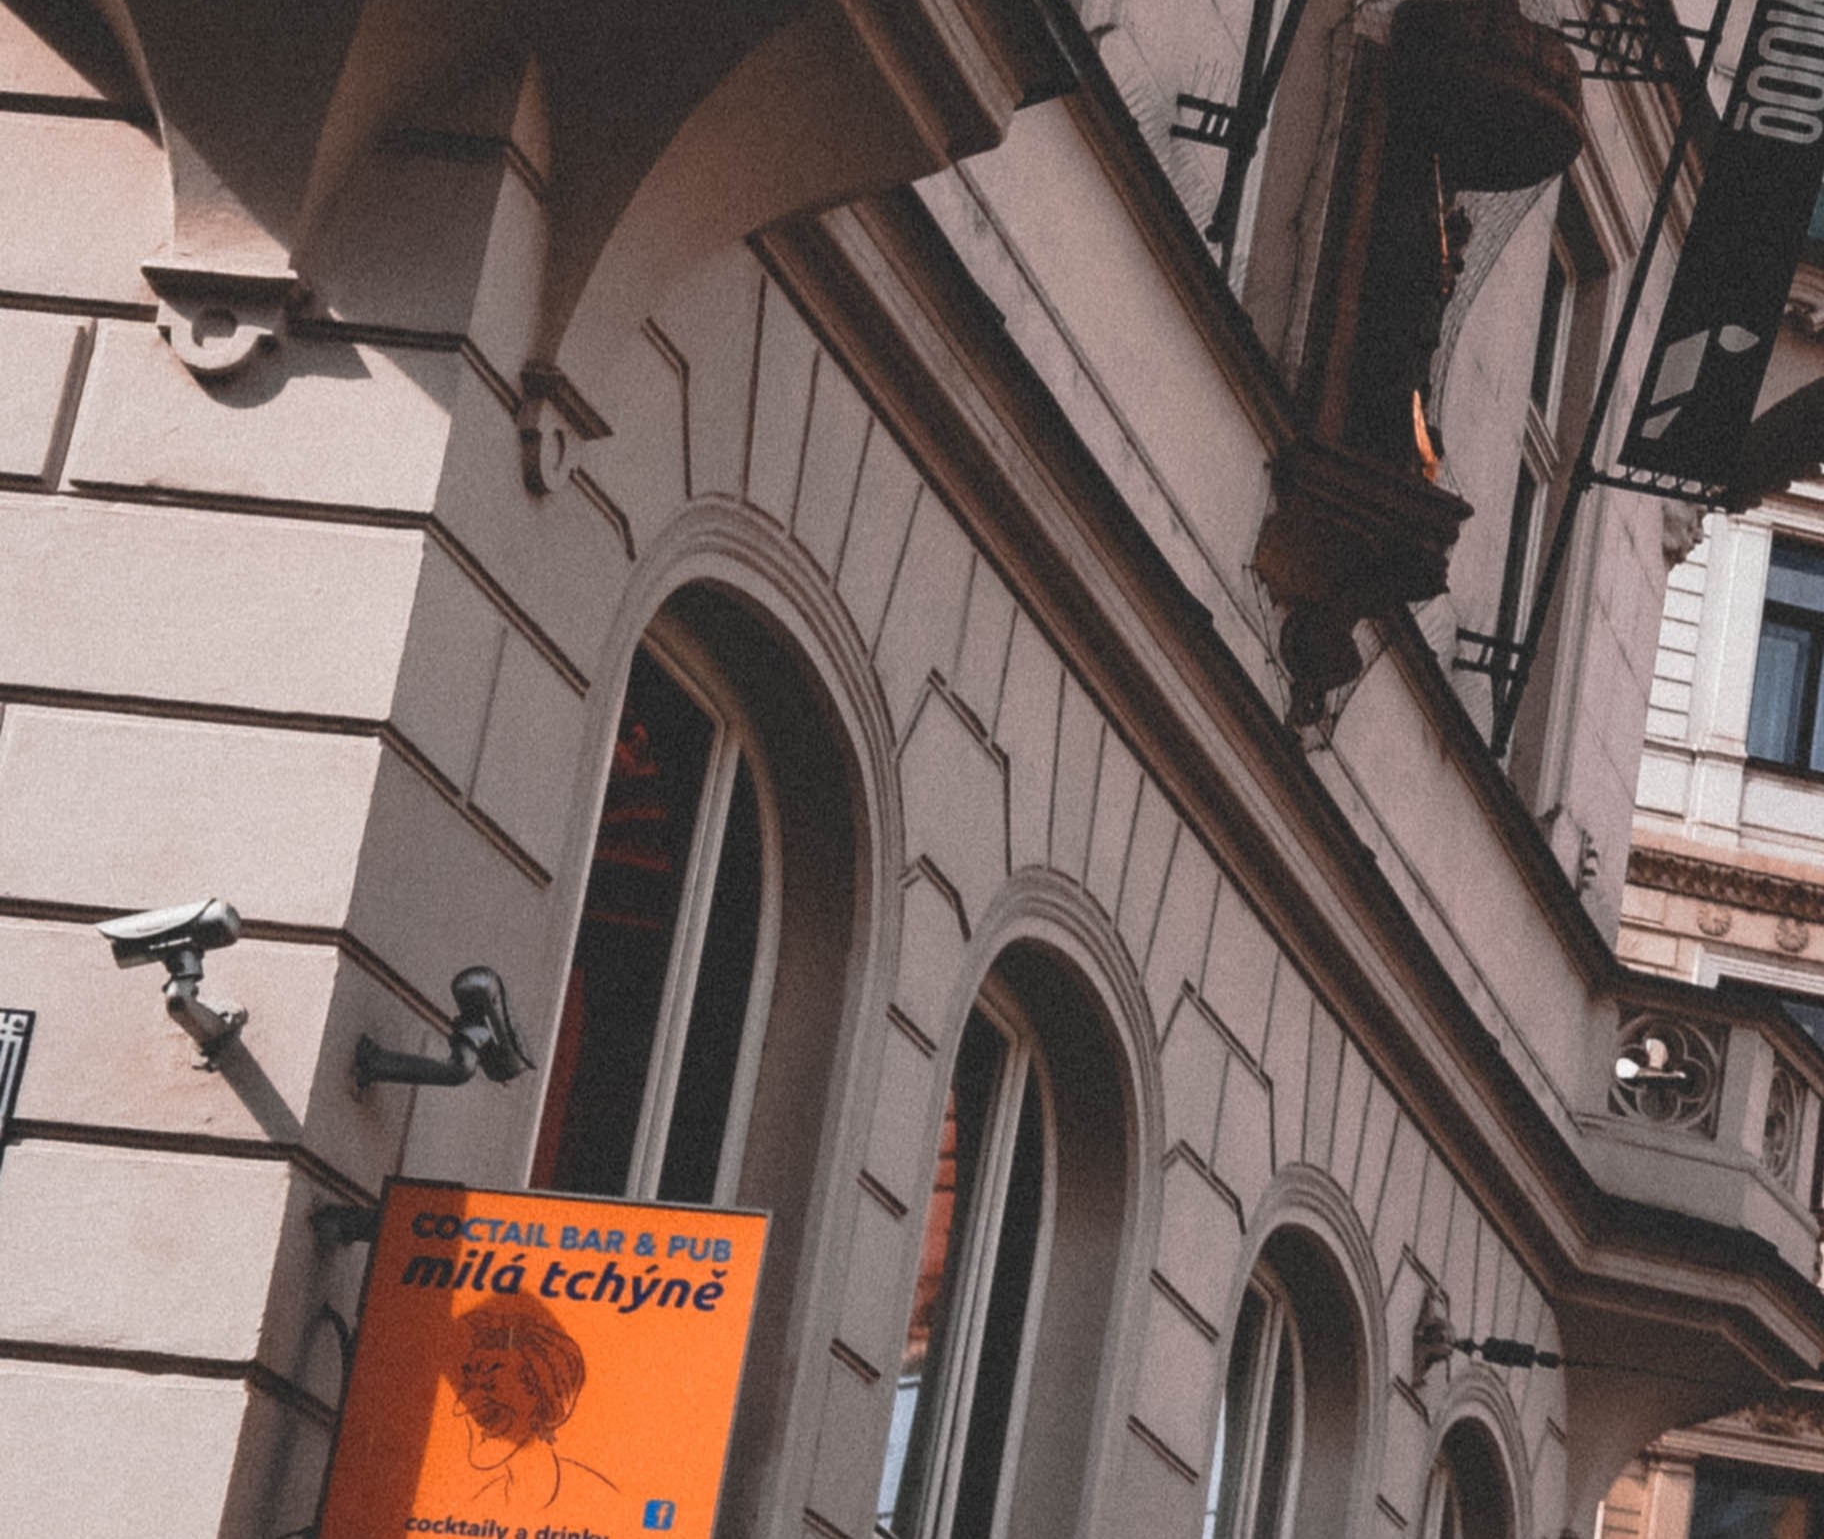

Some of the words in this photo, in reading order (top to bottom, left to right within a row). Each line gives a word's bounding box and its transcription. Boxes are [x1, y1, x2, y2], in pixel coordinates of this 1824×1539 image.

[411, 1212, 550, 1248] COCTAIL
[560, 1226, 625, 1254] BAR
[634, 1233, 656, 1257] &
[667, 1236, 732, 1262] PUB
[401, 1250, 526, 1294] milá
[540, 1261, 728, 1313] tchýně
[404, 1516, 509, 1538] cocktaily
[515, 1528, 528, 1538] a
